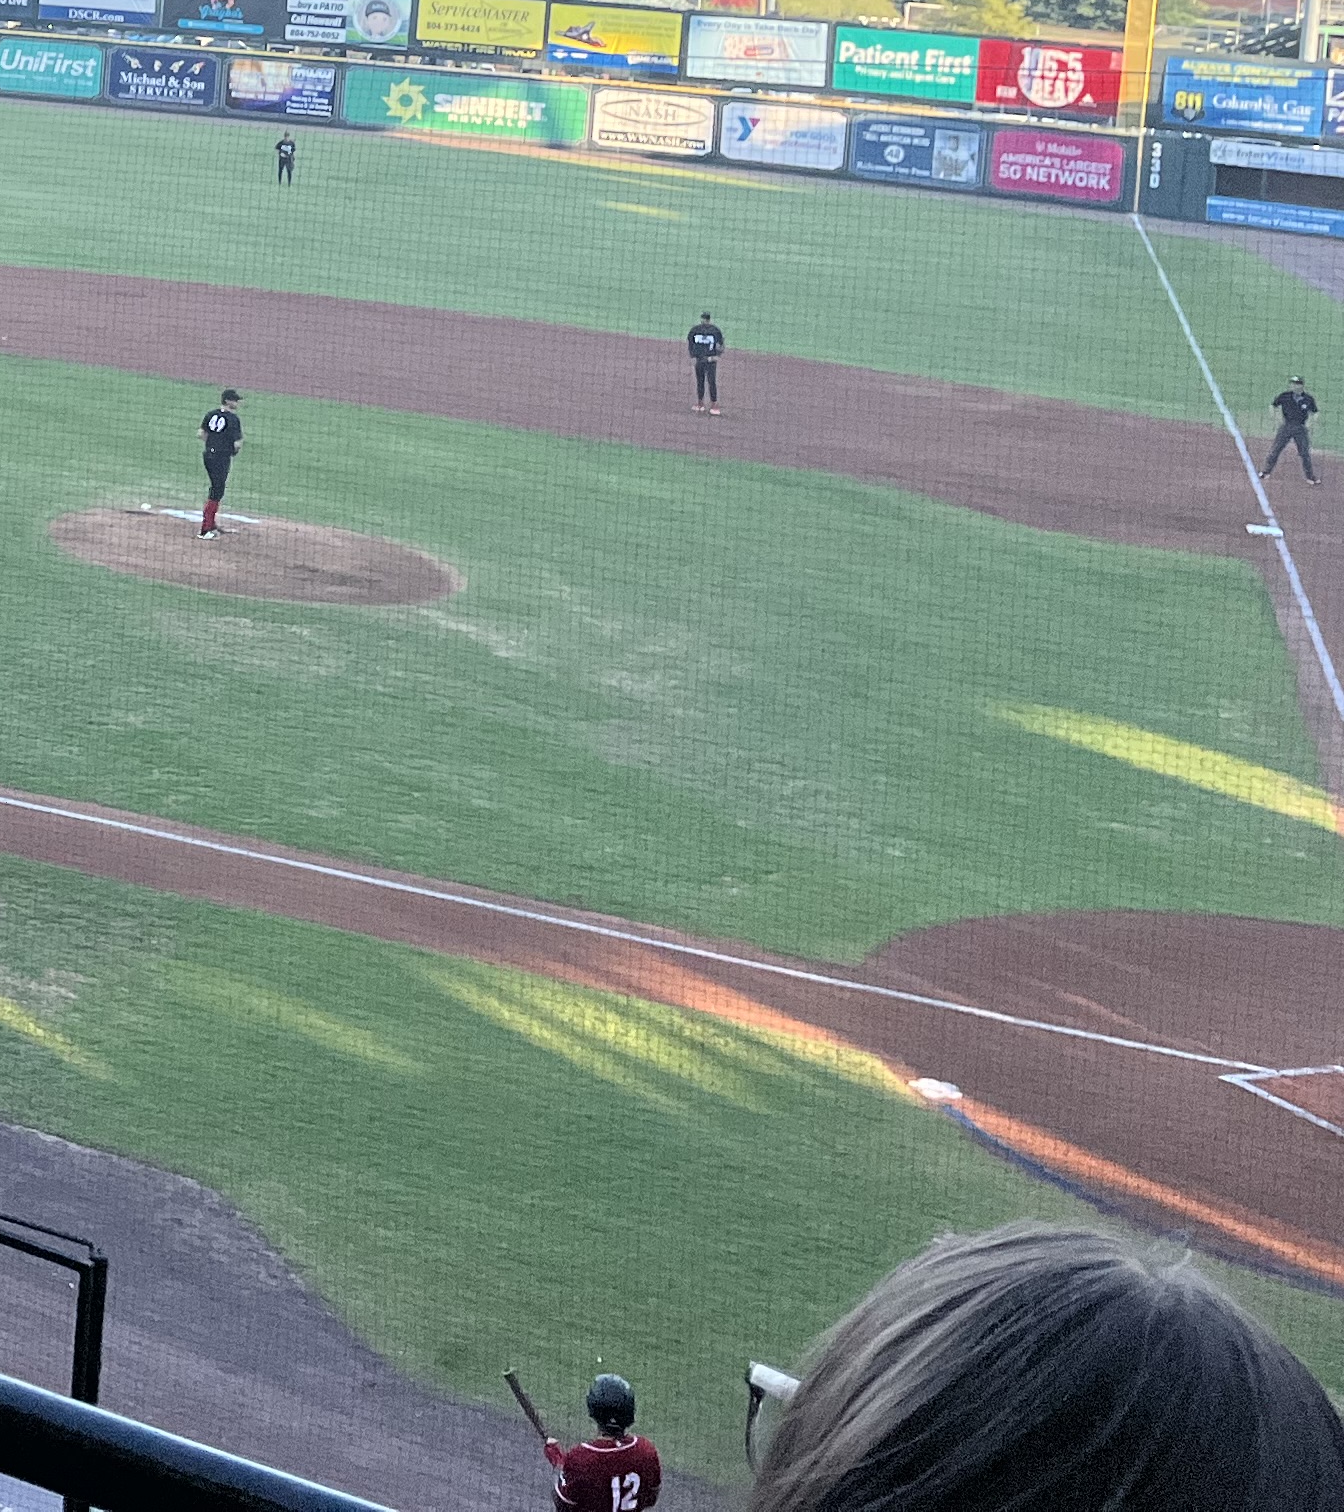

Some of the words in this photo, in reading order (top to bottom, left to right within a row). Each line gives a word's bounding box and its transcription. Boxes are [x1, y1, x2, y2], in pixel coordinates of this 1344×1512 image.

[68, 8, 125, 23] DSCR.com
[319, 2, 344, 11] PATIO
[696, 20, 722, 30] Every
[724, 21, 741, 32] Day
[744, 21, 751, 30] is
[754, 22, 774, 32] Take
[801, 25, 820, 35] Day
[422, 40, 462, 52] WATER
[0, 48, 95, 77] UniFirst
[839, 40, 920, 70] Patient
[924, 48, 973, 75] First
[119, 71, 166, 88] Michael
[167, 75, 180, 88] &
[182, 76, 205, 90] Son
[129, 85, 194, 99] SERVICES
[433, 93, 546, 121] SUNBELT
[1212, 93, 1278, 113] Columbia
[448, 113, 527, 129] RENTALS
[629, 105, 677, 121] NASH
[999, 153, 1061, 166] AMERICA'S
[1062, 156, 1113, 173] LARGEST
[1149, 141, 1163, 189] 330
[998, 163, 1022, 180] 5G
[1025, 166, 1111, 190] NETWORK
[611, 1471, 641, 1512] 12
